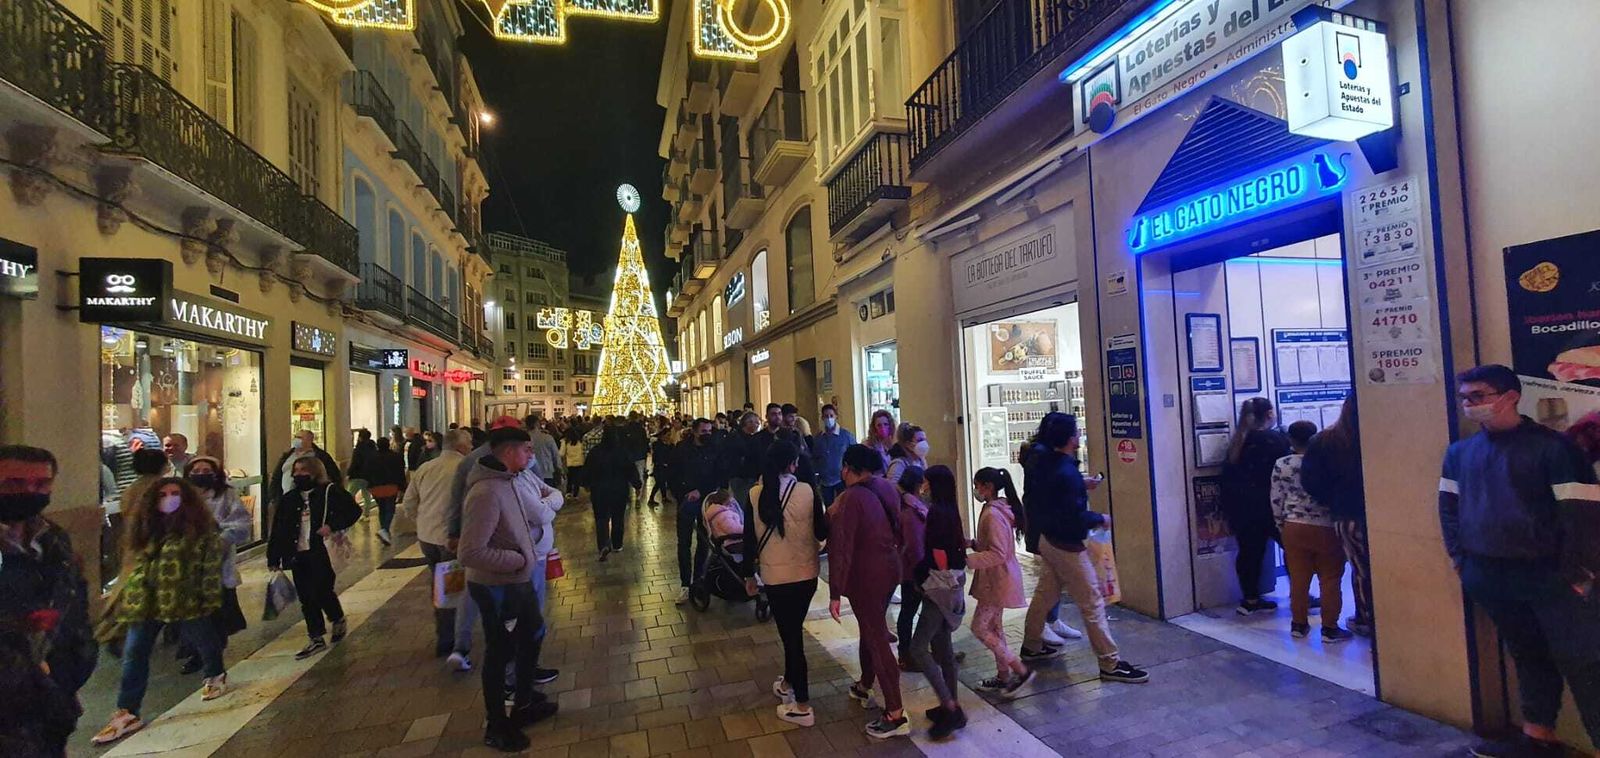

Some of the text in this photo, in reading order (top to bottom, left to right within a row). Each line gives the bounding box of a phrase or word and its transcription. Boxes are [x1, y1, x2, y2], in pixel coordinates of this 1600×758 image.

[1126, 0, 1221, 72] Loterías y
[1127, 0, 1260, 97] Apuestas del
[1133, 102, 1143, 116] El
[1144, 89, 1169, 110] Gato
[1173, 70, 1207, 93] Negro
[1341, 92, 1382, 106] Apuestas del
[1341, 102, 1364, 114] Estado
[1152, 166, 1301, 238] EL GATO NEGRO
[1369, 195, 1408, 210] PREMIO
[1377, 222, 1409, 233] PREMIO
[977, 253, 1003, 280] BOTTEGA
[1005, 247, 1017, 270] DEL
[1019, 234, 1052, 264] TARTUFO
[1376, 263, 1420, 278] PREMIO
[1369, 275, 1413, 290] 04211
[86, 297, 154, 306] MAKARTHY
[1384, 305, 1413, 313] PREMIO
[172, 299, 267, 339] MAKARTHY
[1372, 313, 1418, 327] 41710
[1379, 348, 1422, 359] PREMIO
[1377, 357, 1419, 369] 18065
